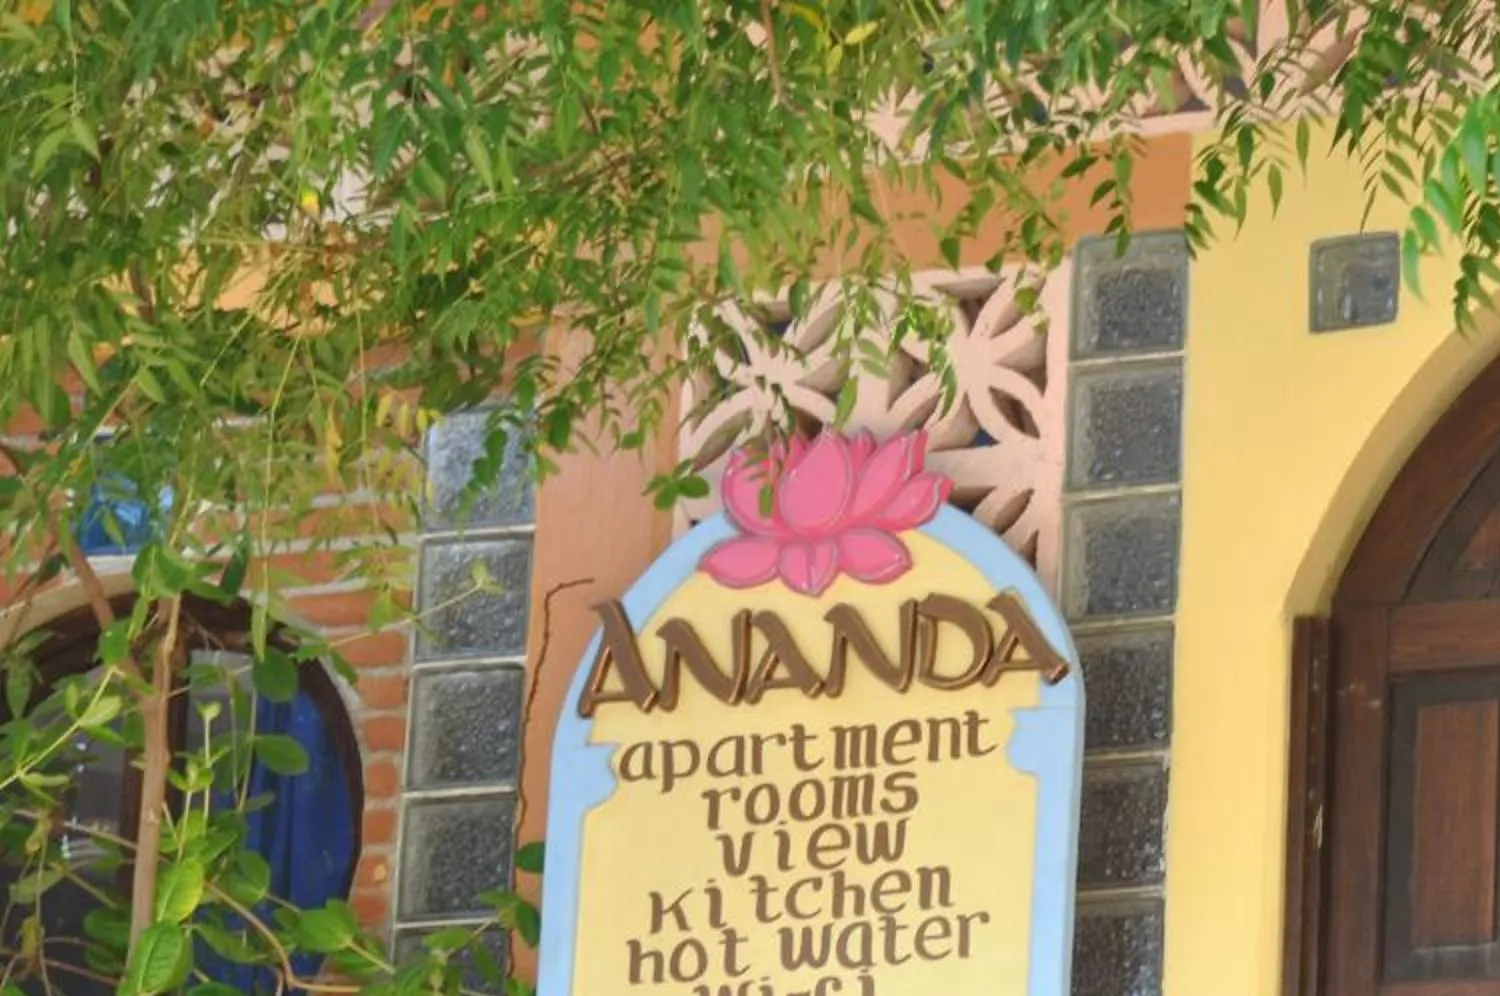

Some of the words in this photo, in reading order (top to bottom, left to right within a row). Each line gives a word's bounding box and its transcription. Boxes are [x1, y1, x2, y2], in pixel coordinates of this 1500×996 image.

[578, 591, 1069, 718] ANANDA
[618, 708, 999, 793] apartment
[702, 770, 919, 830] rooms
[717, 818, 907, 876] view
[626, 928, 750, 986] hot
[778, 911, 990, 971] water
